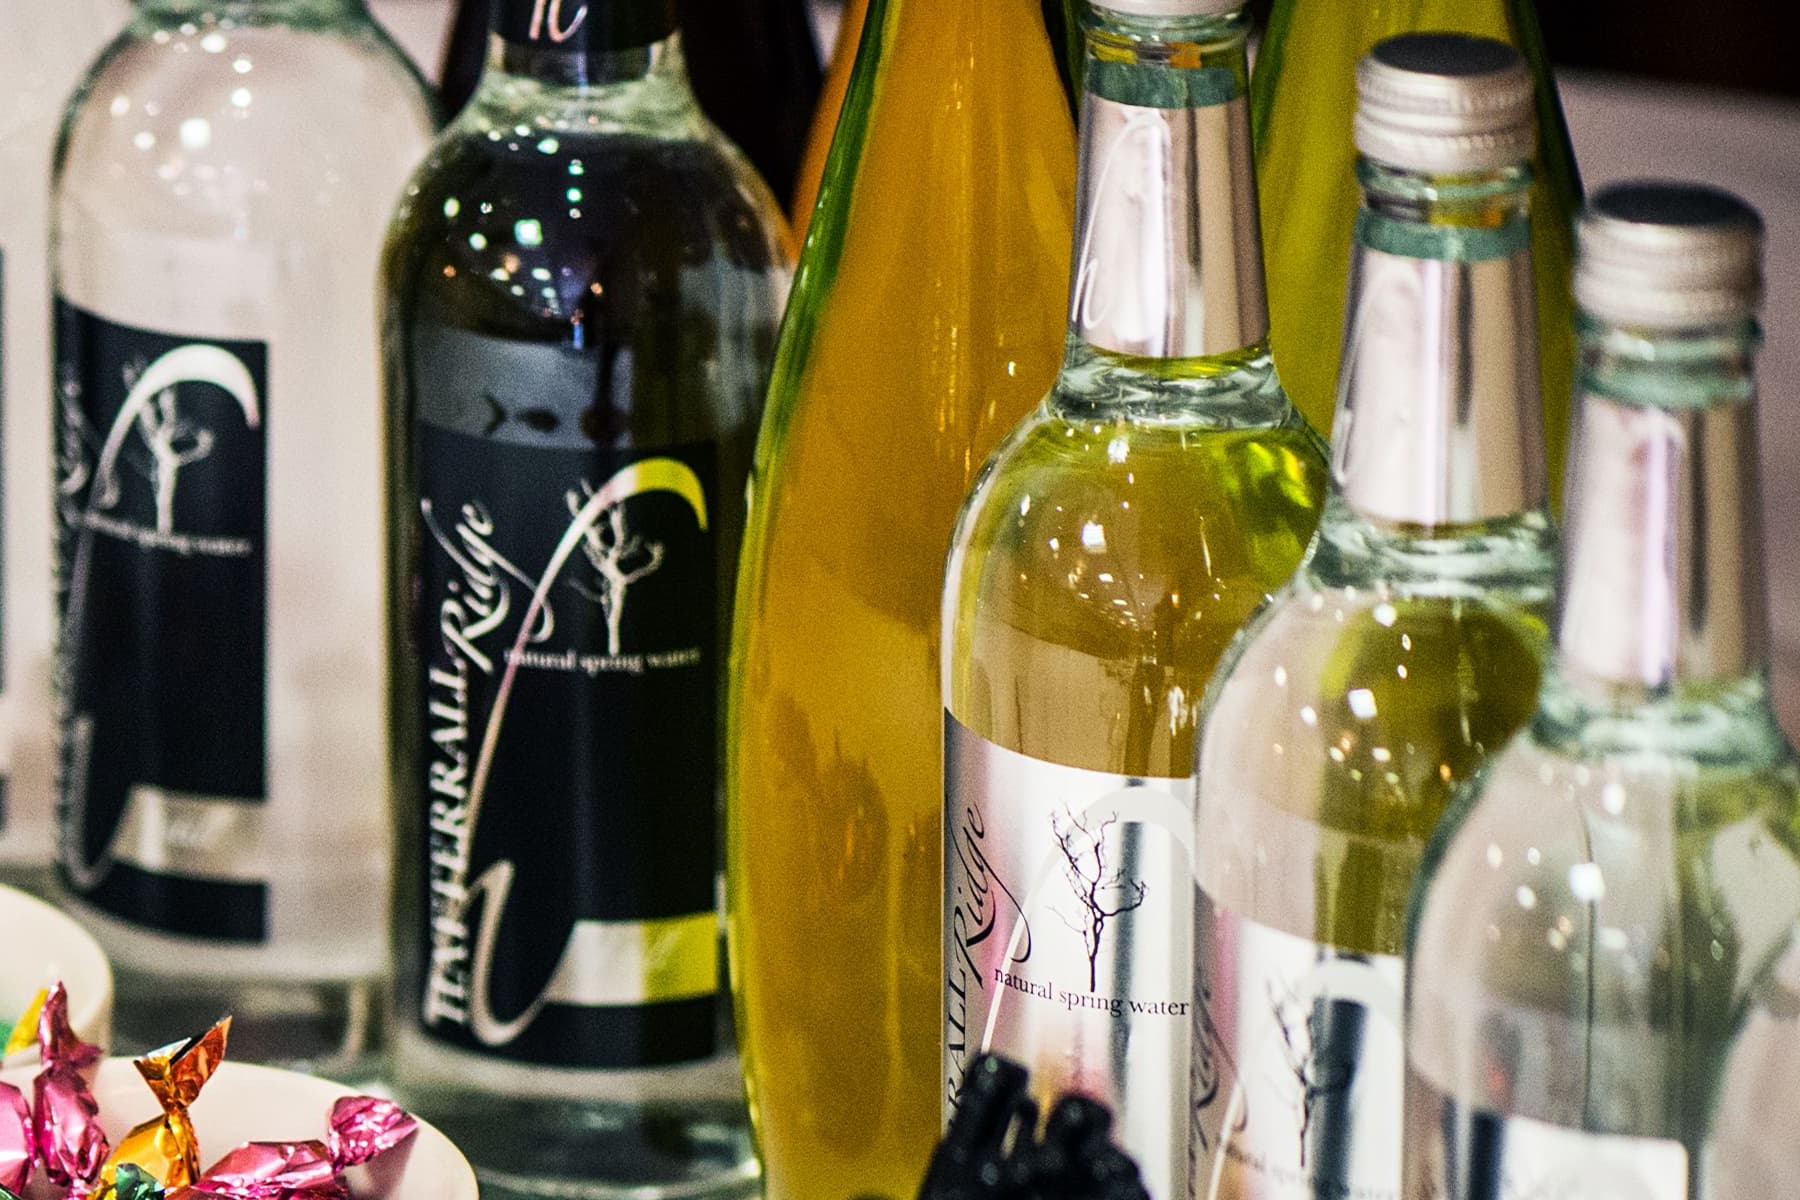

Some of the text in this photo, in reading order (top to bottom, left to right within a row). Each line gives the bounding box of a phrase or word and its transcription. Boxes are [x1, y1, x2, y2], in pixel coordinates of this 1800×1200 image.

[421, 498, 554, 674] Ridge
[945, 798, 1032, 990] Ridge
[994, 968, 1190, 1018] natural spring water
